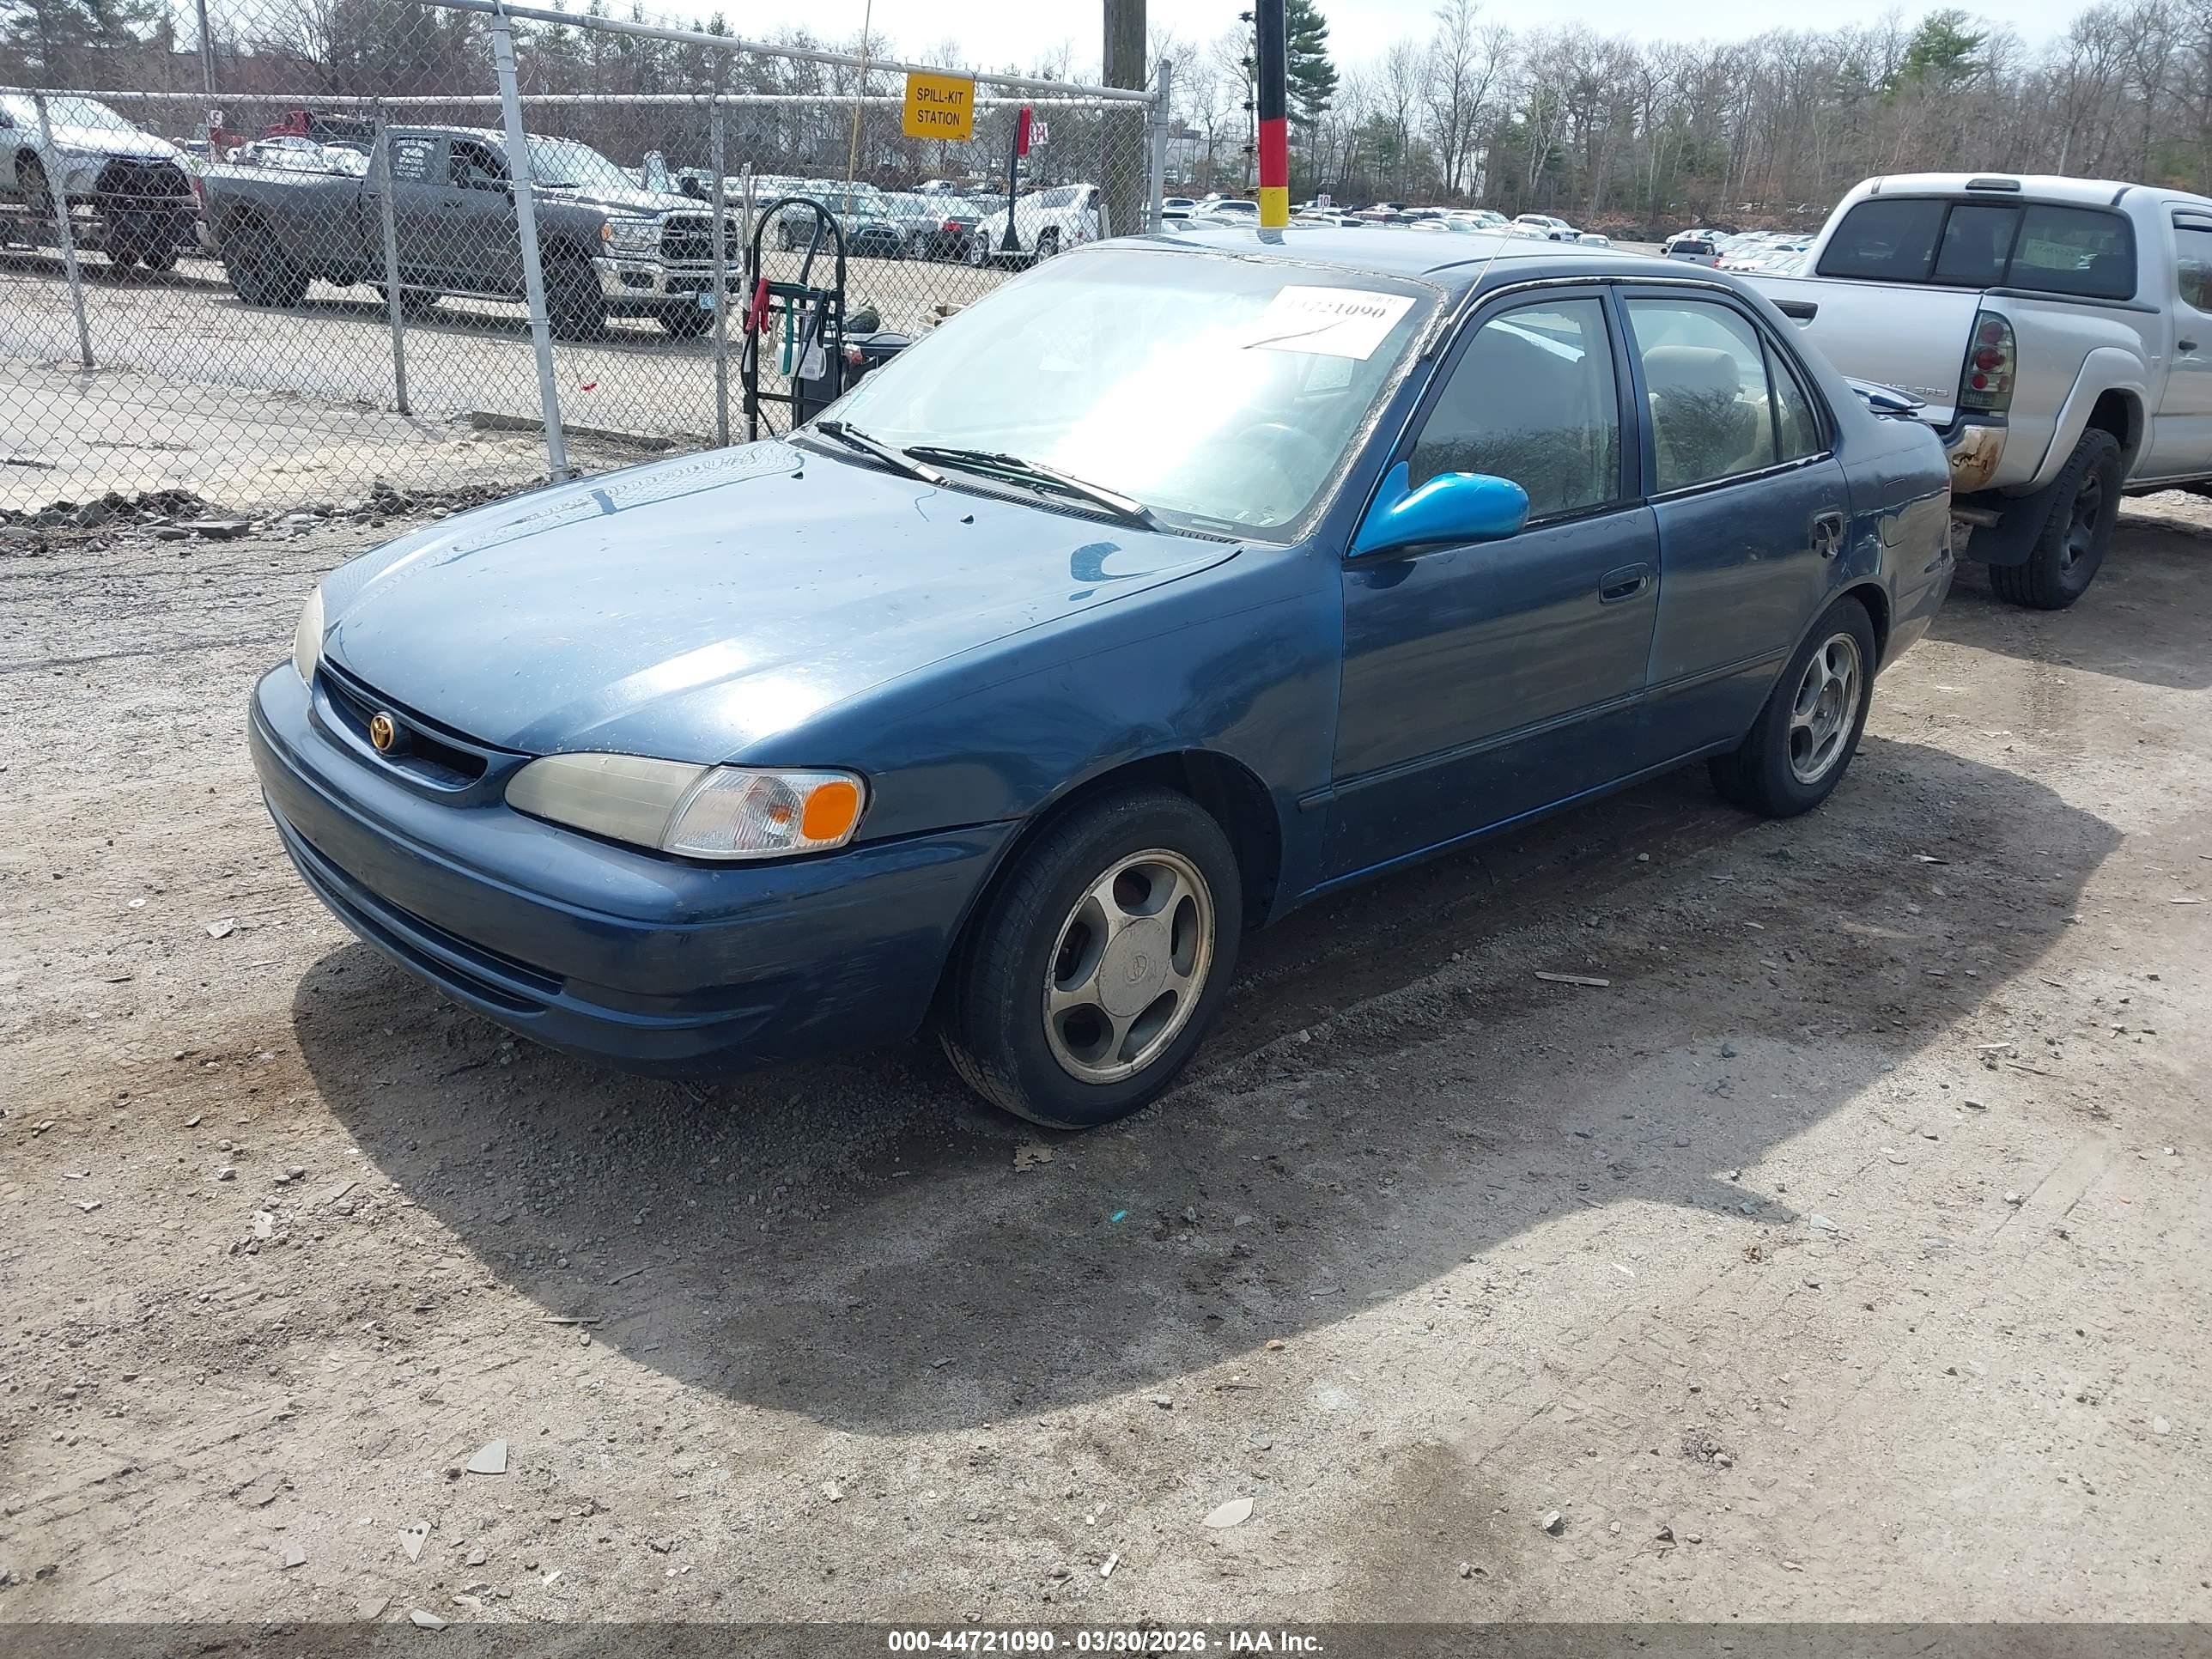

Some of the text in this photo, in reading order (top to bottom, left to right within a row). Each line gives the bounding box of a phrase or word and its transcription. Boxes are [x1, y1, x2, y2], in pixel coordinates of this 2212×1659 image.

[916, 88, 963, 105] SPILL-KIT
[917, 109, 960, 126] STATION
[1318, 196, 1329, 207] 10
